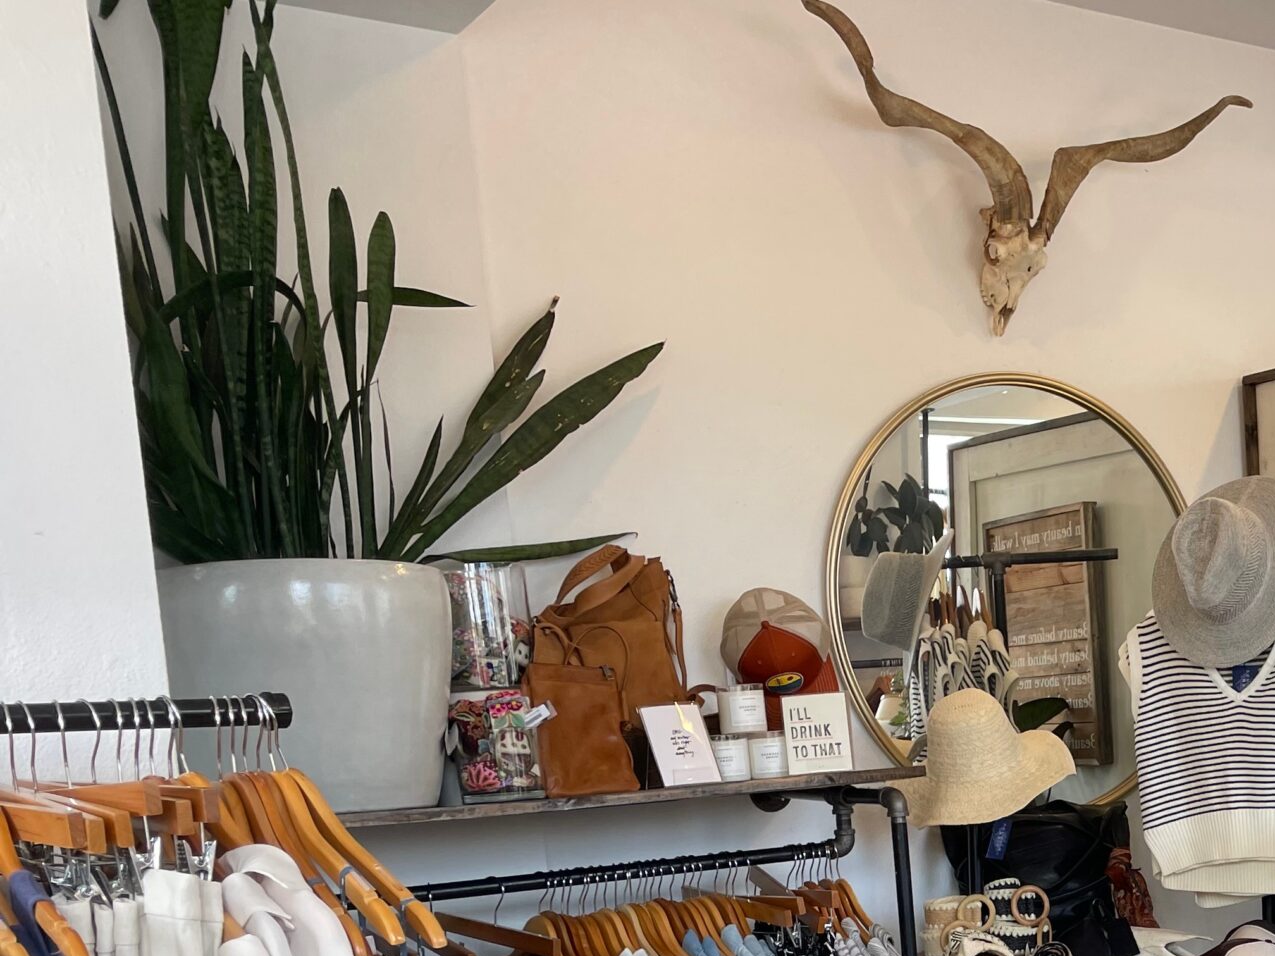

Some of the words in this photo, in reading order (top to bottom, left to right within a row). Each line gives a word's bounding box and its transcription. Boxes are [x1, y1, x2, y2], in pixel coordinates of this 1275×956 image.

[789, 707, 812, 722] I'LL
[790, 724, 832, 740] DRINK
[792, 746, 808, 758] TO
[811, 742, 842, 758] THAT
